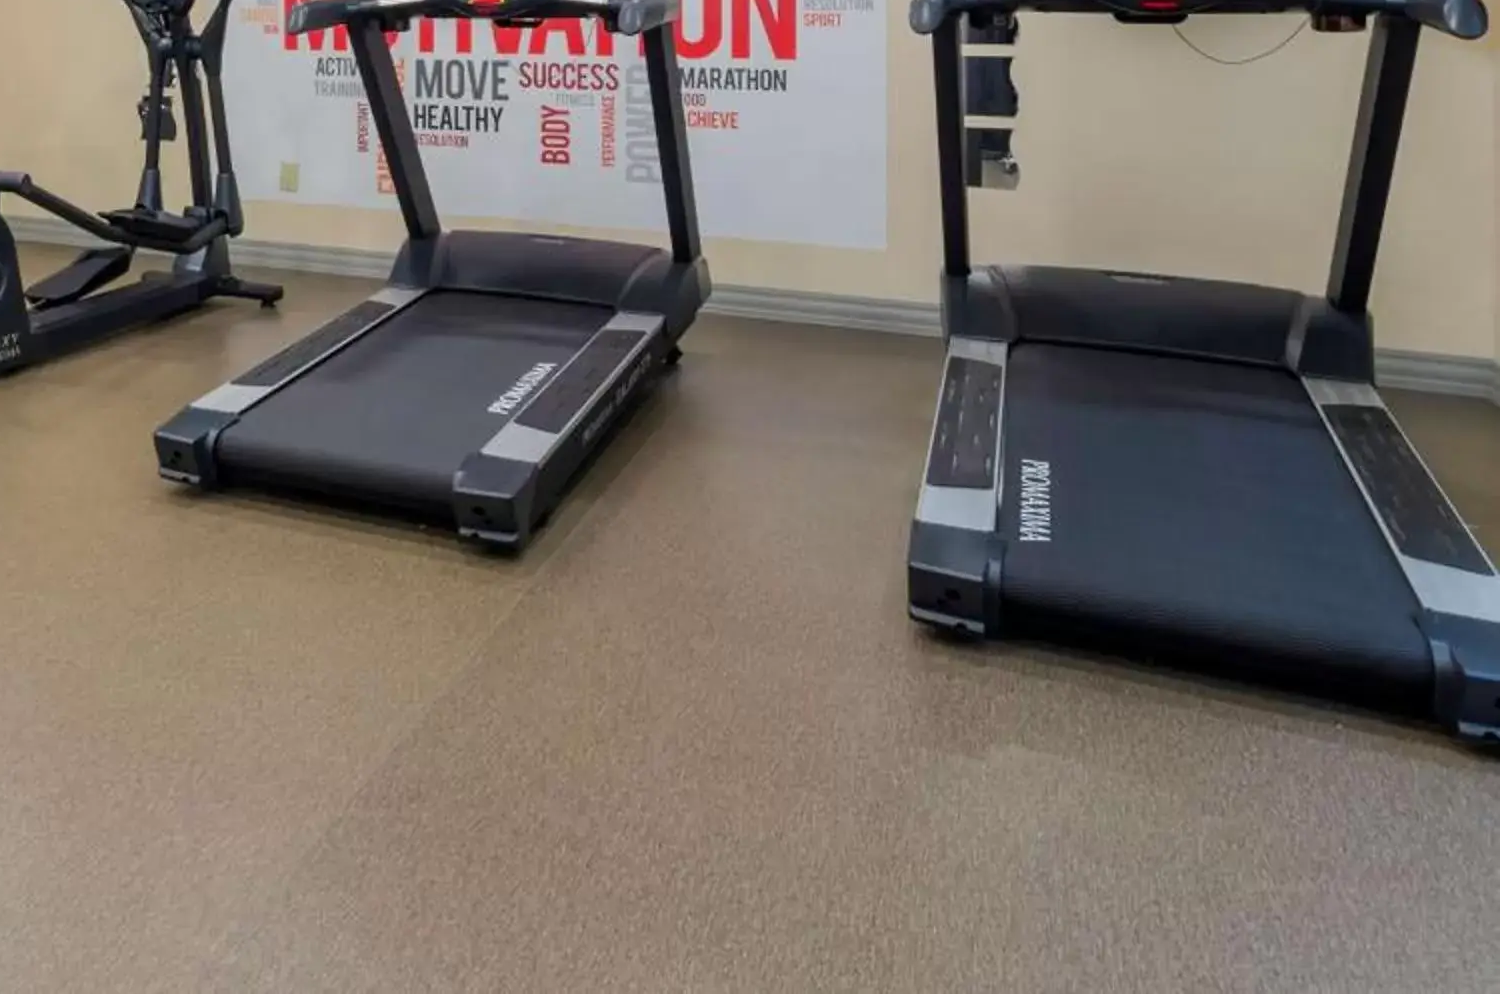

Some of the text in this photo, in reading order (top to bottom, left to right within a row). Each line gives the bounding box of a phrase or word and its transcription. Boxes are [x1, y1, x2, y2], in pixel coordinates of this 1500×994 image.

[803, 13, 842, 27] SPORT
[315, 57, 359, 77] ACTIV
[414, 58, 510, 101] MOVE
[518, 61, 620, 92] SUCCESS
[679, 67, 788, 92] MARATHON
[413, 104, 504, 133] HEALTHY
[687, 110, 739, 129] CHIEVE
[541, 104, 569, 164] BODY
[1019, 459, 1051, 542] PROMAXIMA
